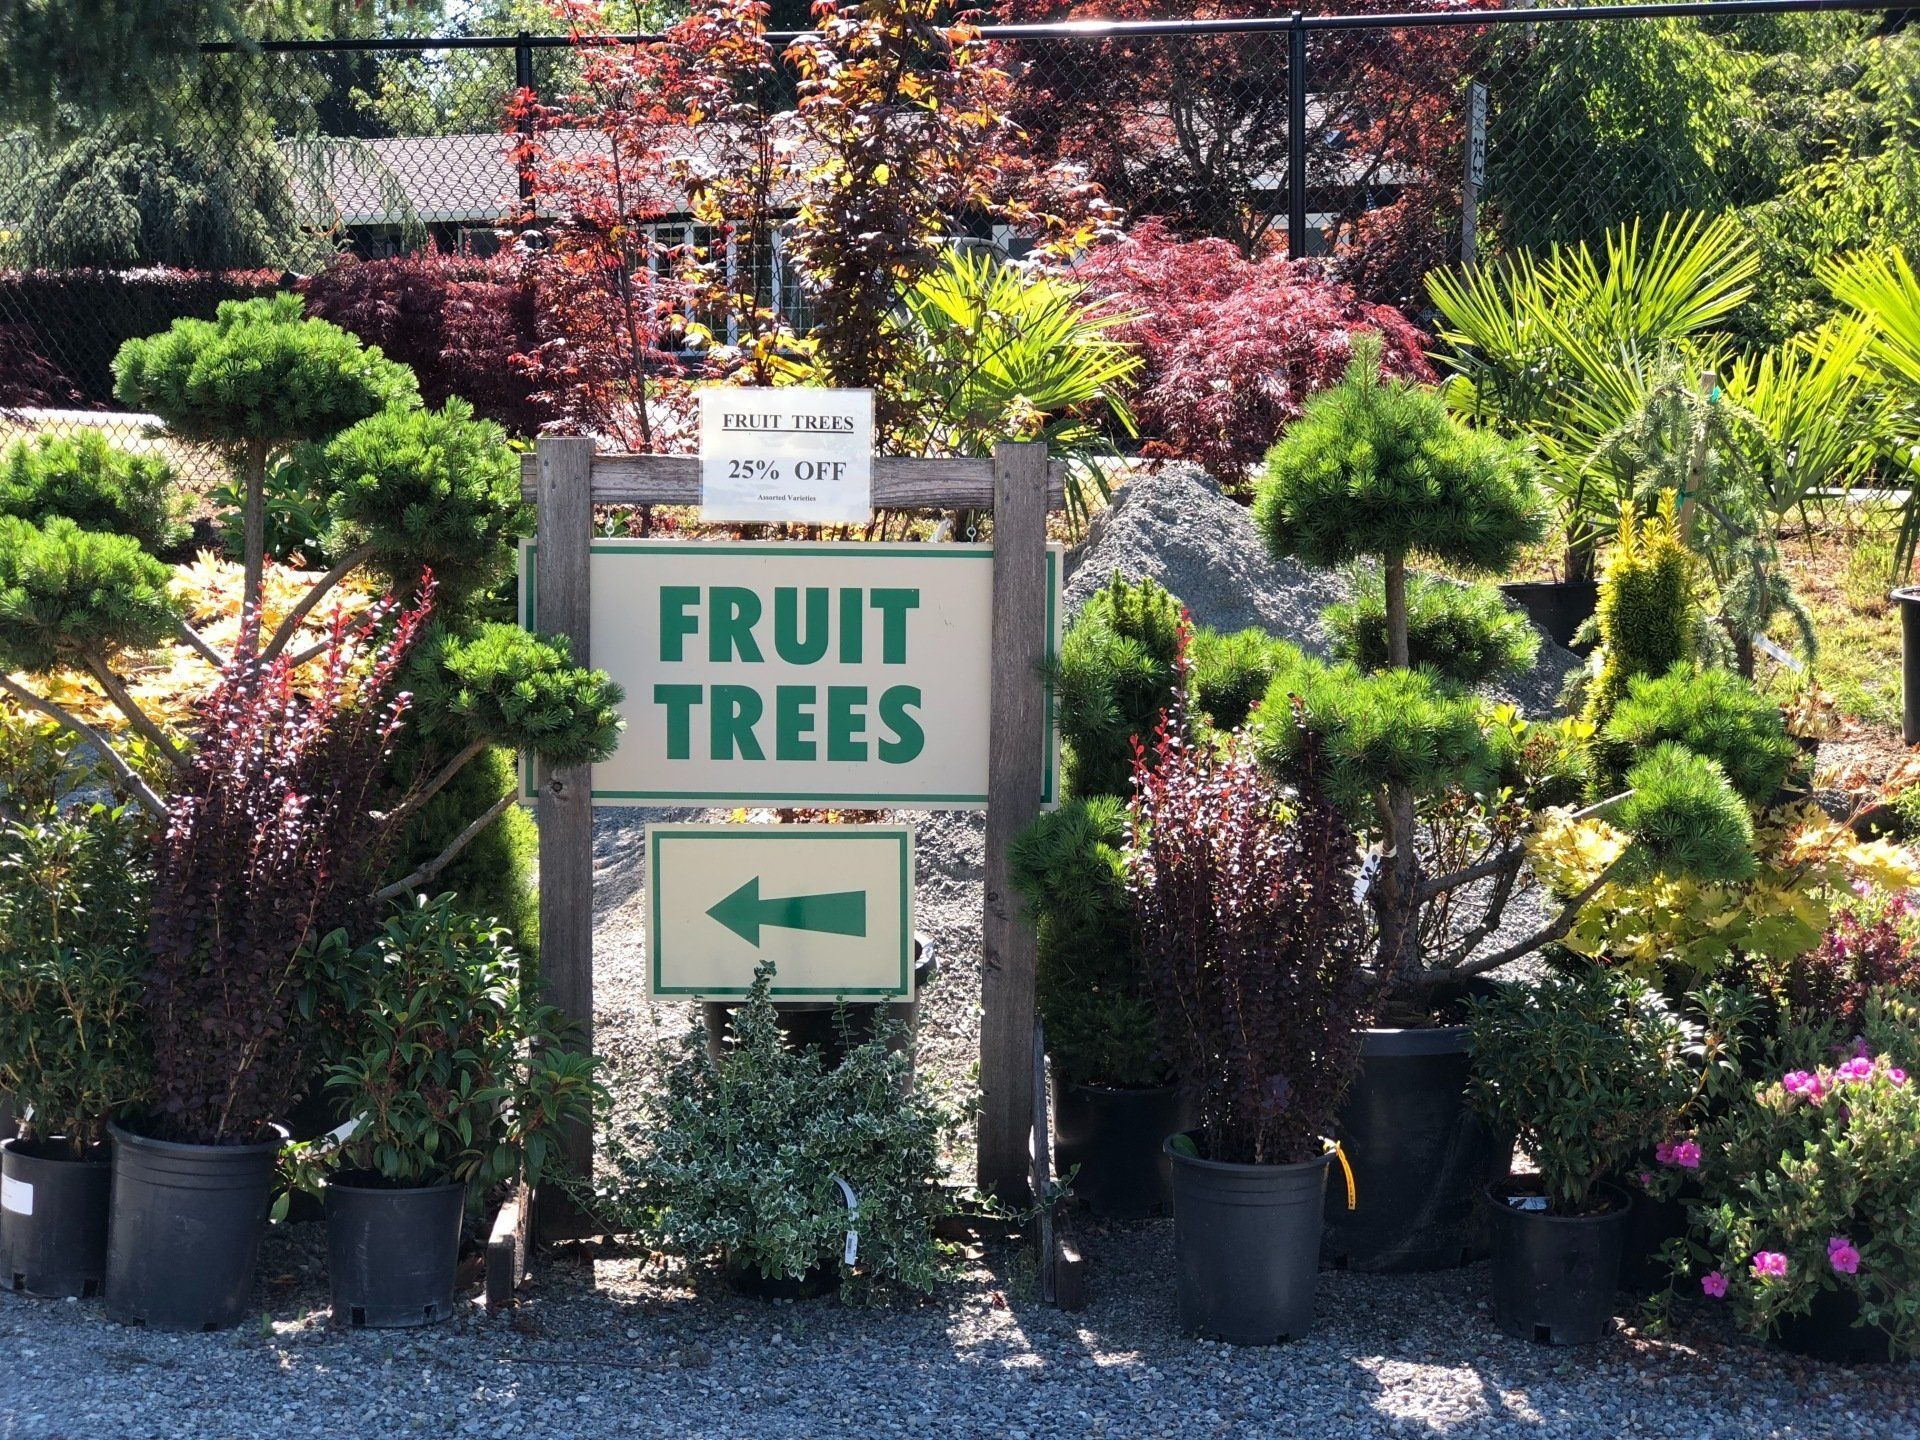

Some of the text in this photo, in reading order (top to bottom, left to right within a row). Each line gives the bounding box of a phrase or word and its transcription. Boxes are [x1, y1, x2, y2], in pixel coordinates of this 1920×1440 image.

[722, 413, 854, 431] FRUIT TREES
[728, 459, 847, 481] 25% OFF
[757, 493, 817, 502] Assorted Varieties
[661, 586, 920, 665] FRUIT
[653, 684, 925, 764] TREES
